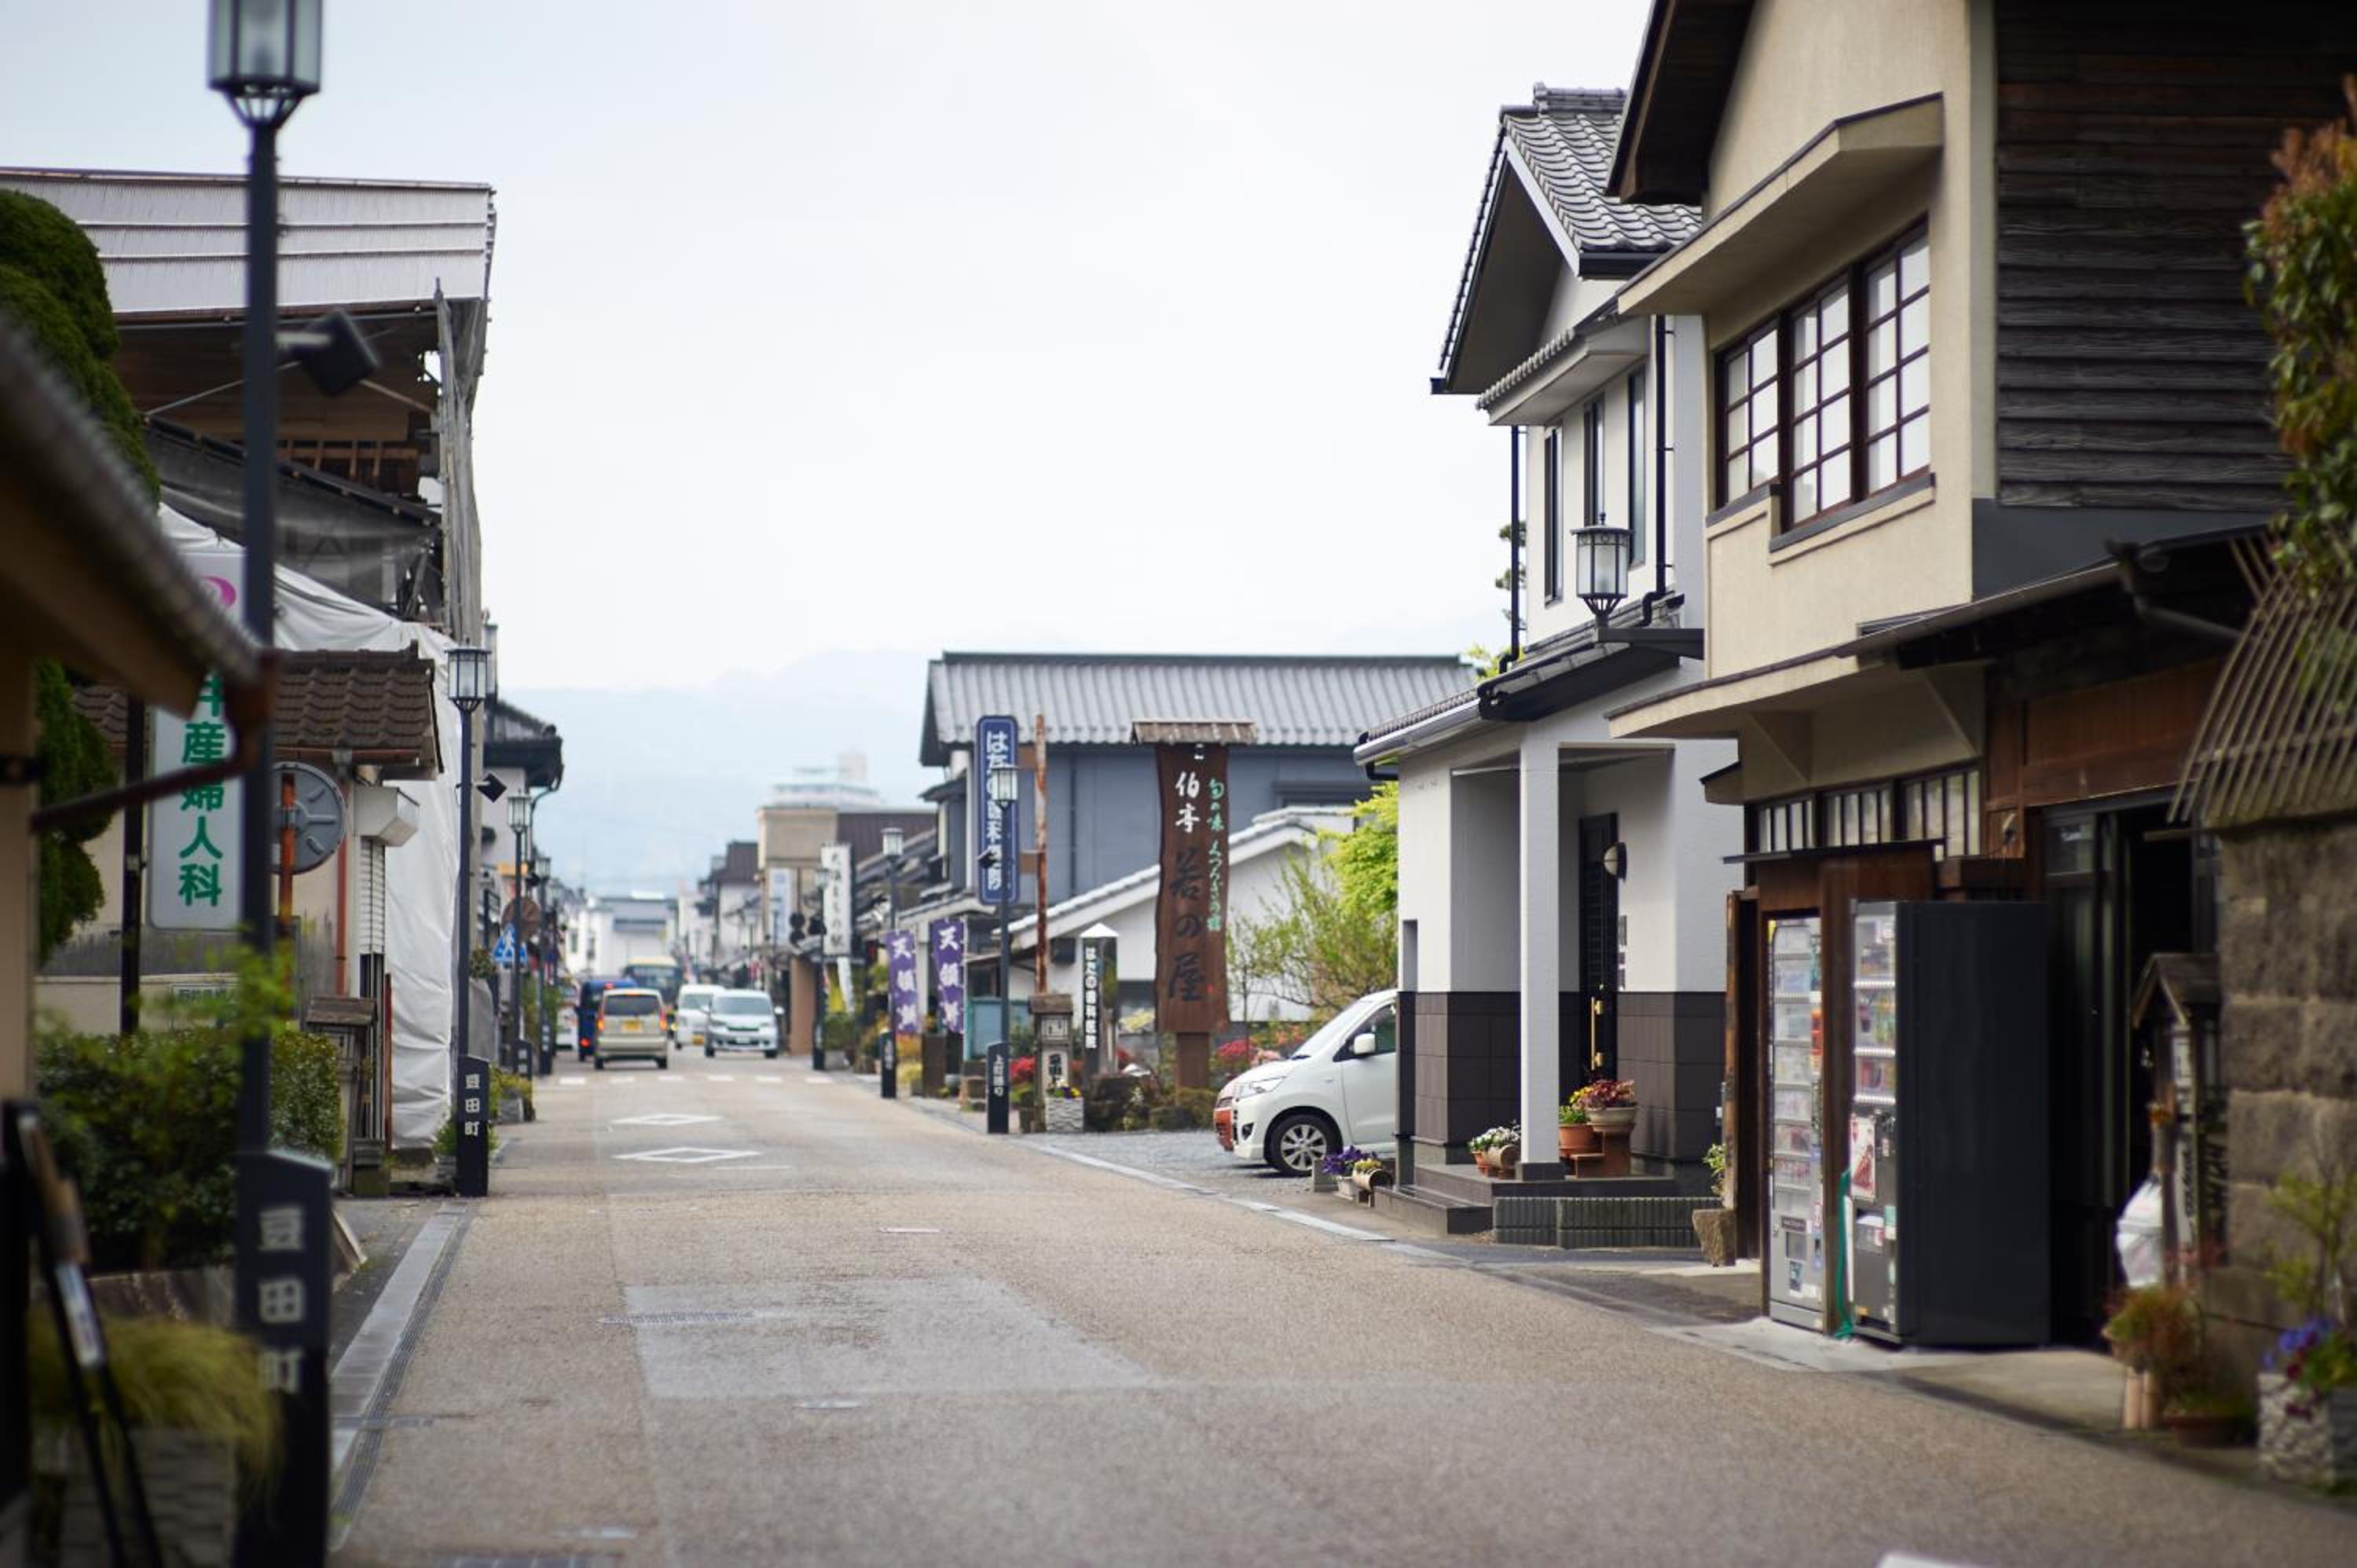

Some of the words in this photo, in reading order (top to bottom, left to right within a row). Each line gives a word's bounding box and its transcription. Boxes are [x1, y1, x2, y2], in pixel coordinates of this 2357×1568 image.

[464, 1073, 480, 1137] 豆田町
[258, 1206, 305, 1394] 豆田町
